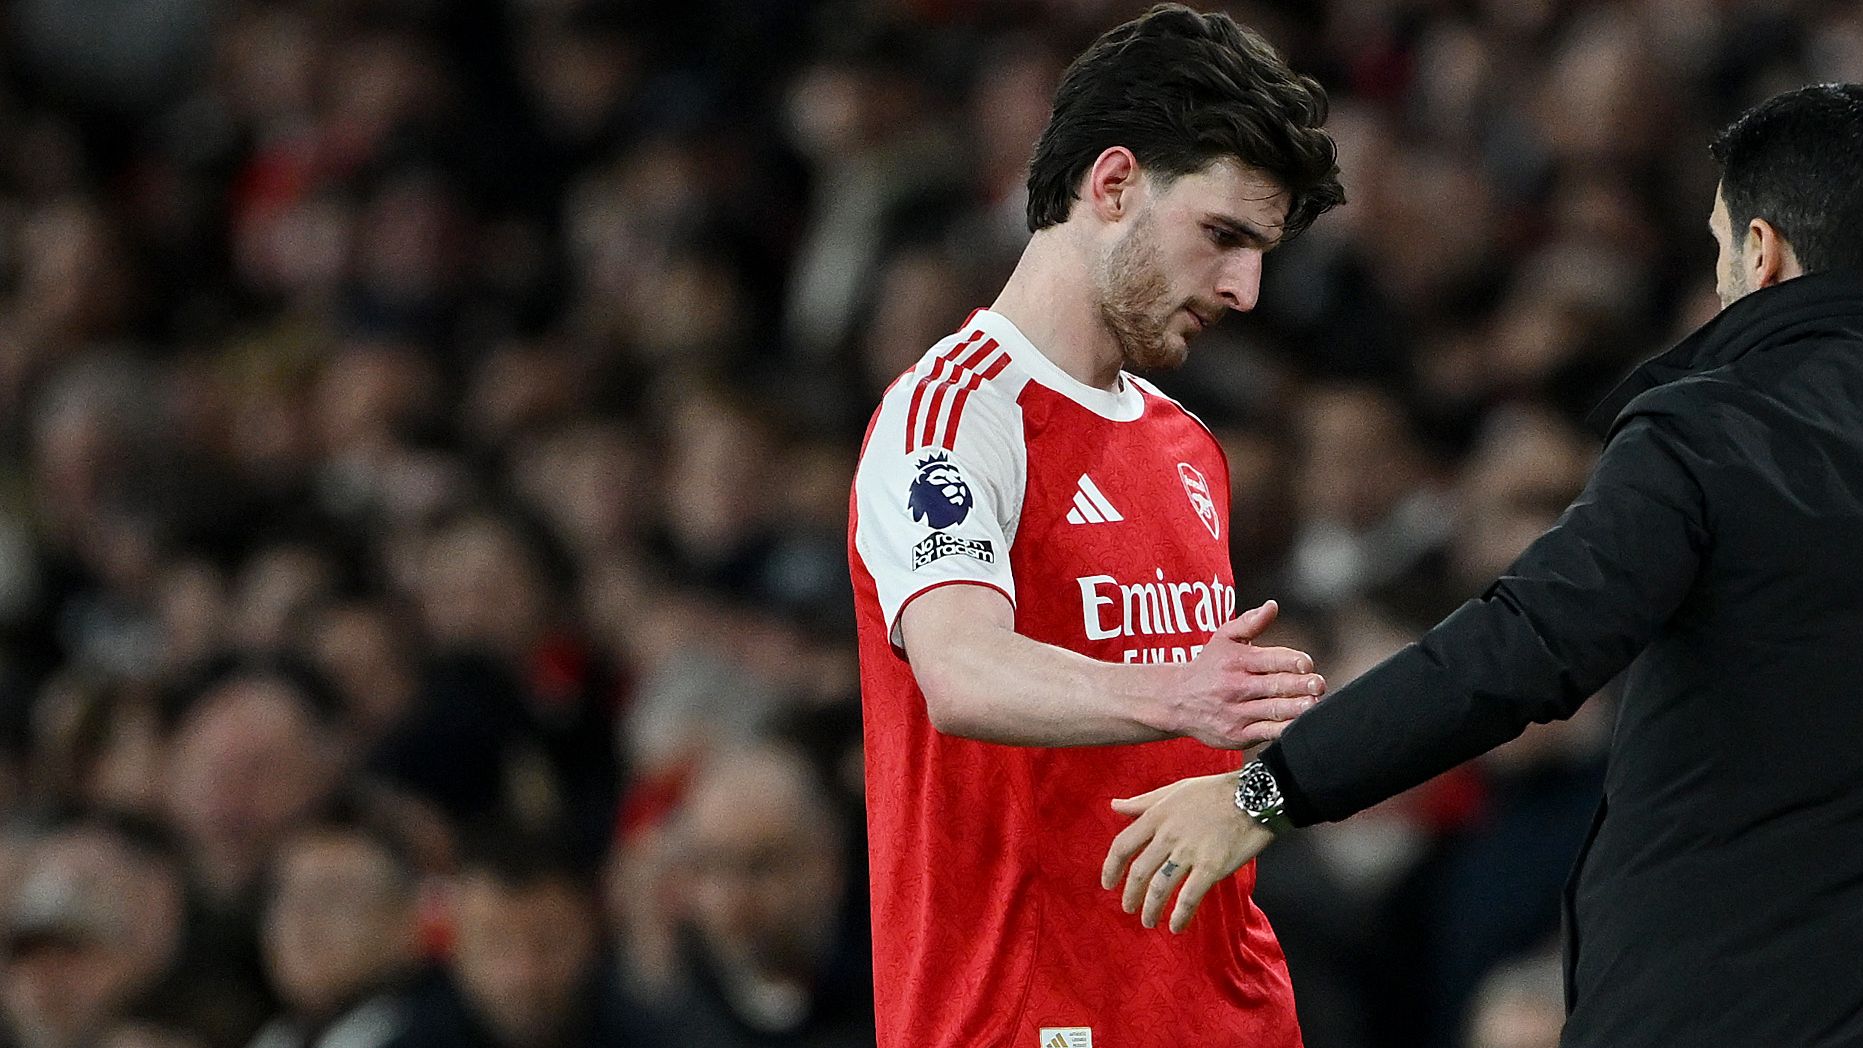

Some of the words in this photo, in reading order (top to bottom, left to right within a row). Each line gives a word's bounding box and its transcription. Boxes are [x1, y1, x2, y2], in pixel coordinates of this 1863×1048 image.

[913, 538, 934, 557] No
[935, 533, 985, 550] room
[913, 549, 934, 570] for
[936, 544, 994, 563] racism
[1076, 567, 1236, 641] Emirate
